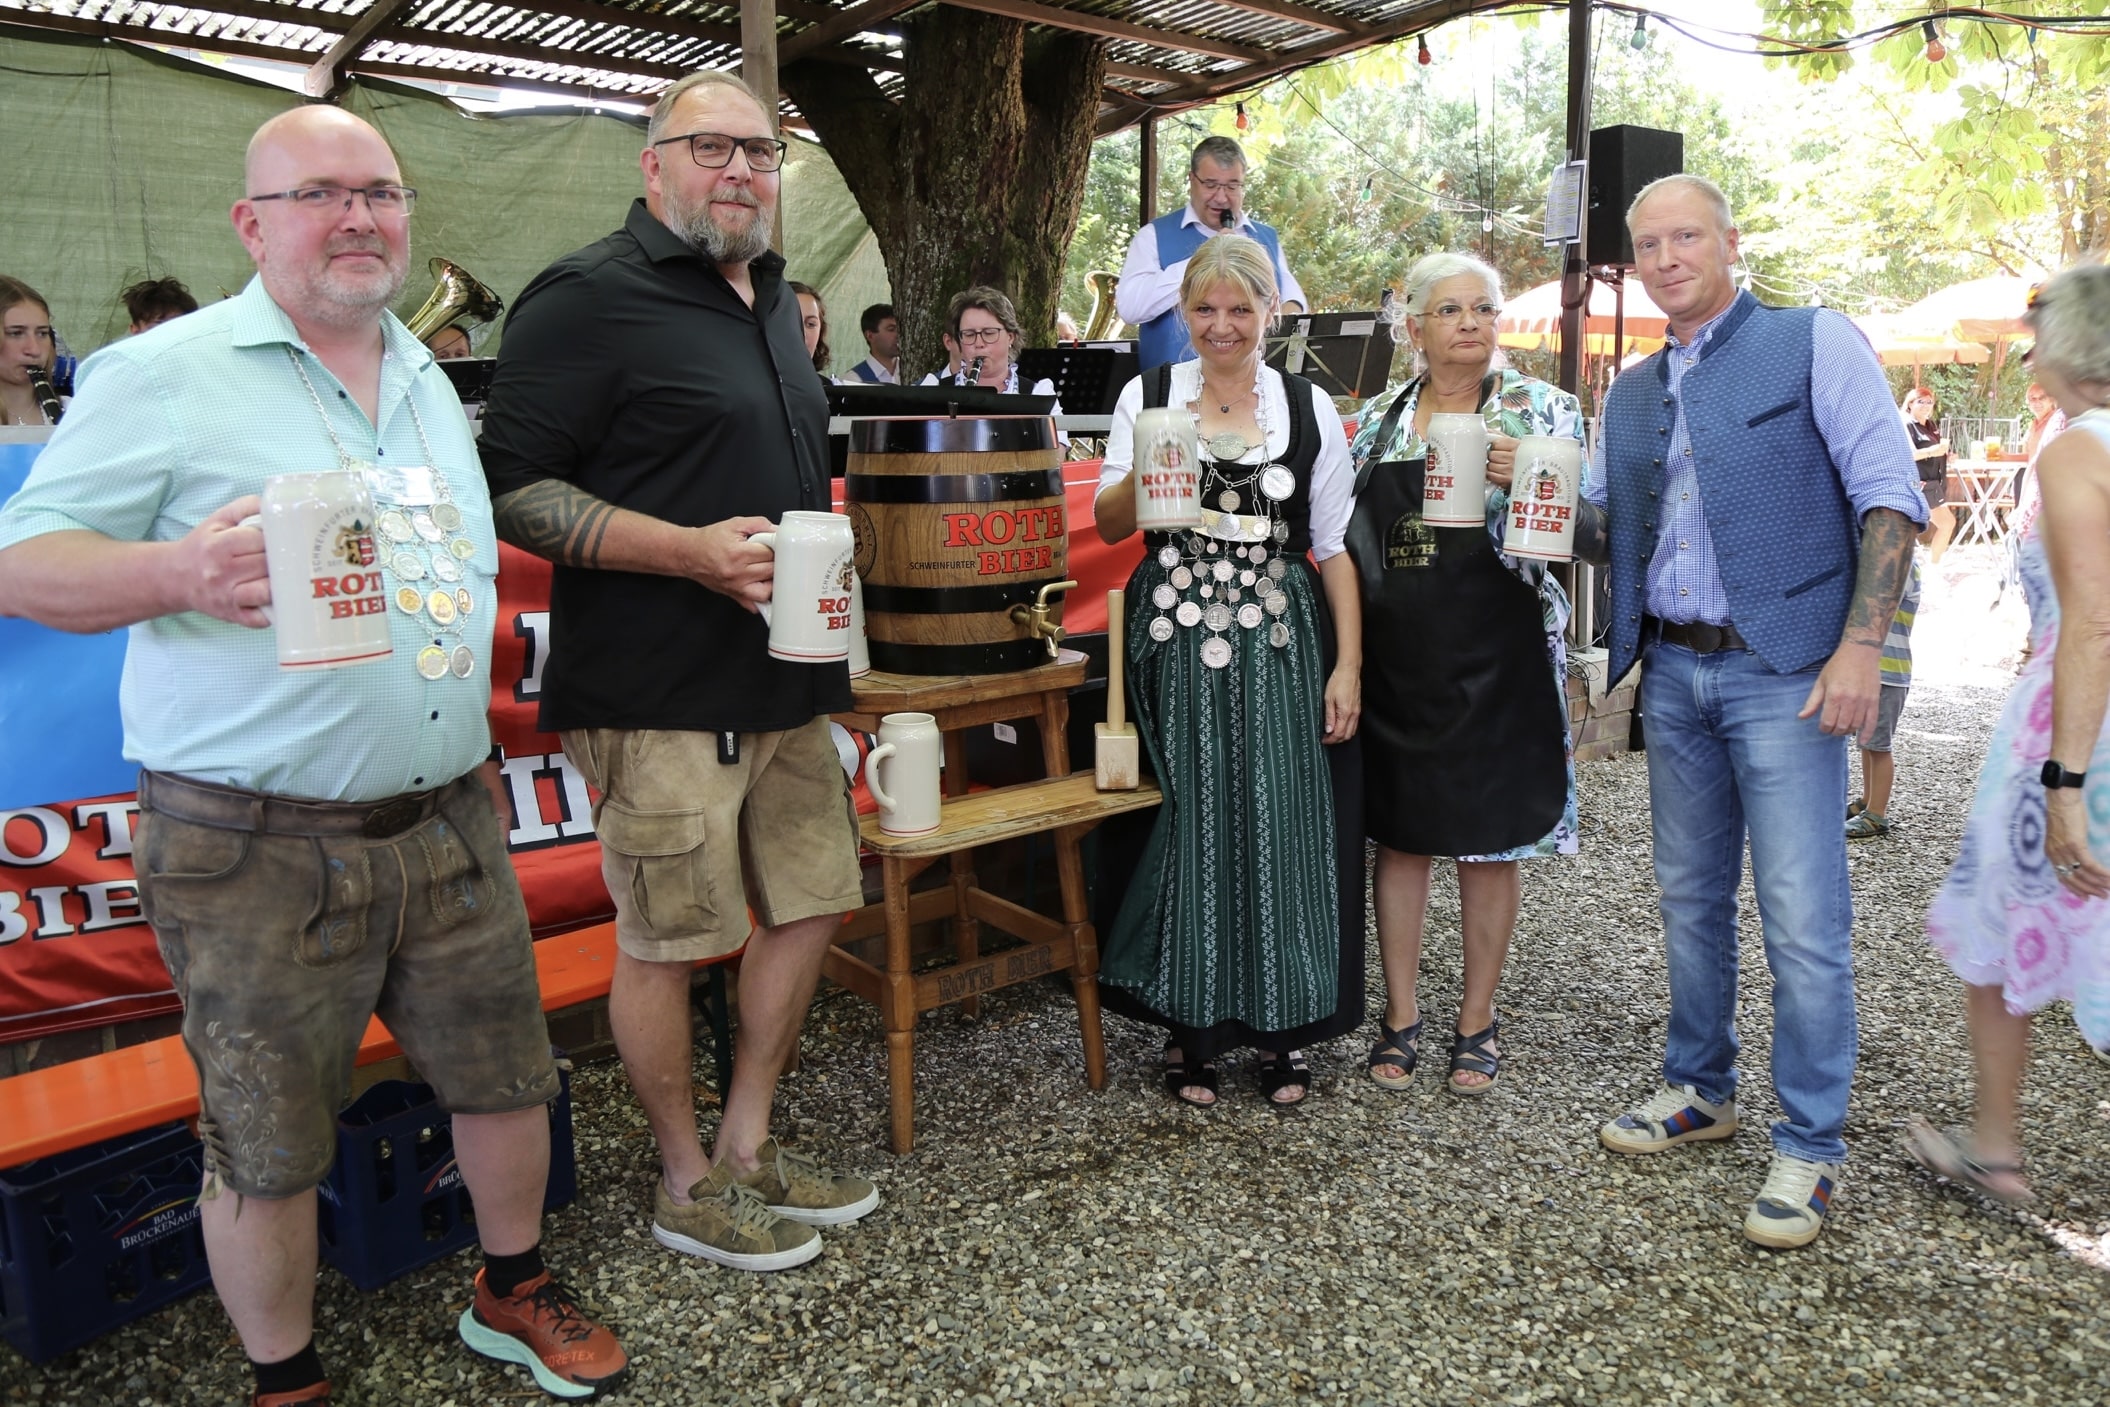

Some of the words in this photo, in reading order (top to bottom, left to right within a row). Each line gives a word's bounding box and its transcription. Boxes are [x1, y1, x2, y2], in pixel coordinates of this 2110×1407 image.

[1141, 472, 1197, 486] ROTH
[1424, 474, 1454, 488] TH
[1148, 488, 1193, 499] BIER
[1424, 489, 1446, 501] ER
[1512, 500, 1572, 520] ROTH
[942, 505, 1065, 548] ROTH
[1514, 517, 1563, 533] BIER
[1388, 543, 1436, 558] ROTH
[910, 560, 976, 571] SCHWEINFURTER
[977, 545, 1052, 576] BIER
[1393, 556, 1430, 568] BIER
[310, 571, 384, 599] ROT
[329, 595, 387, 620] BIE
[817, 596, 851, 614] RO
[938, 963, 995, 1001] ROTH
[1007, 945, 1053, 982] BIER
[153, 1209, 176, 1225] BAD
[120, 1207, 201, 1250] BRÜCKENAUE
